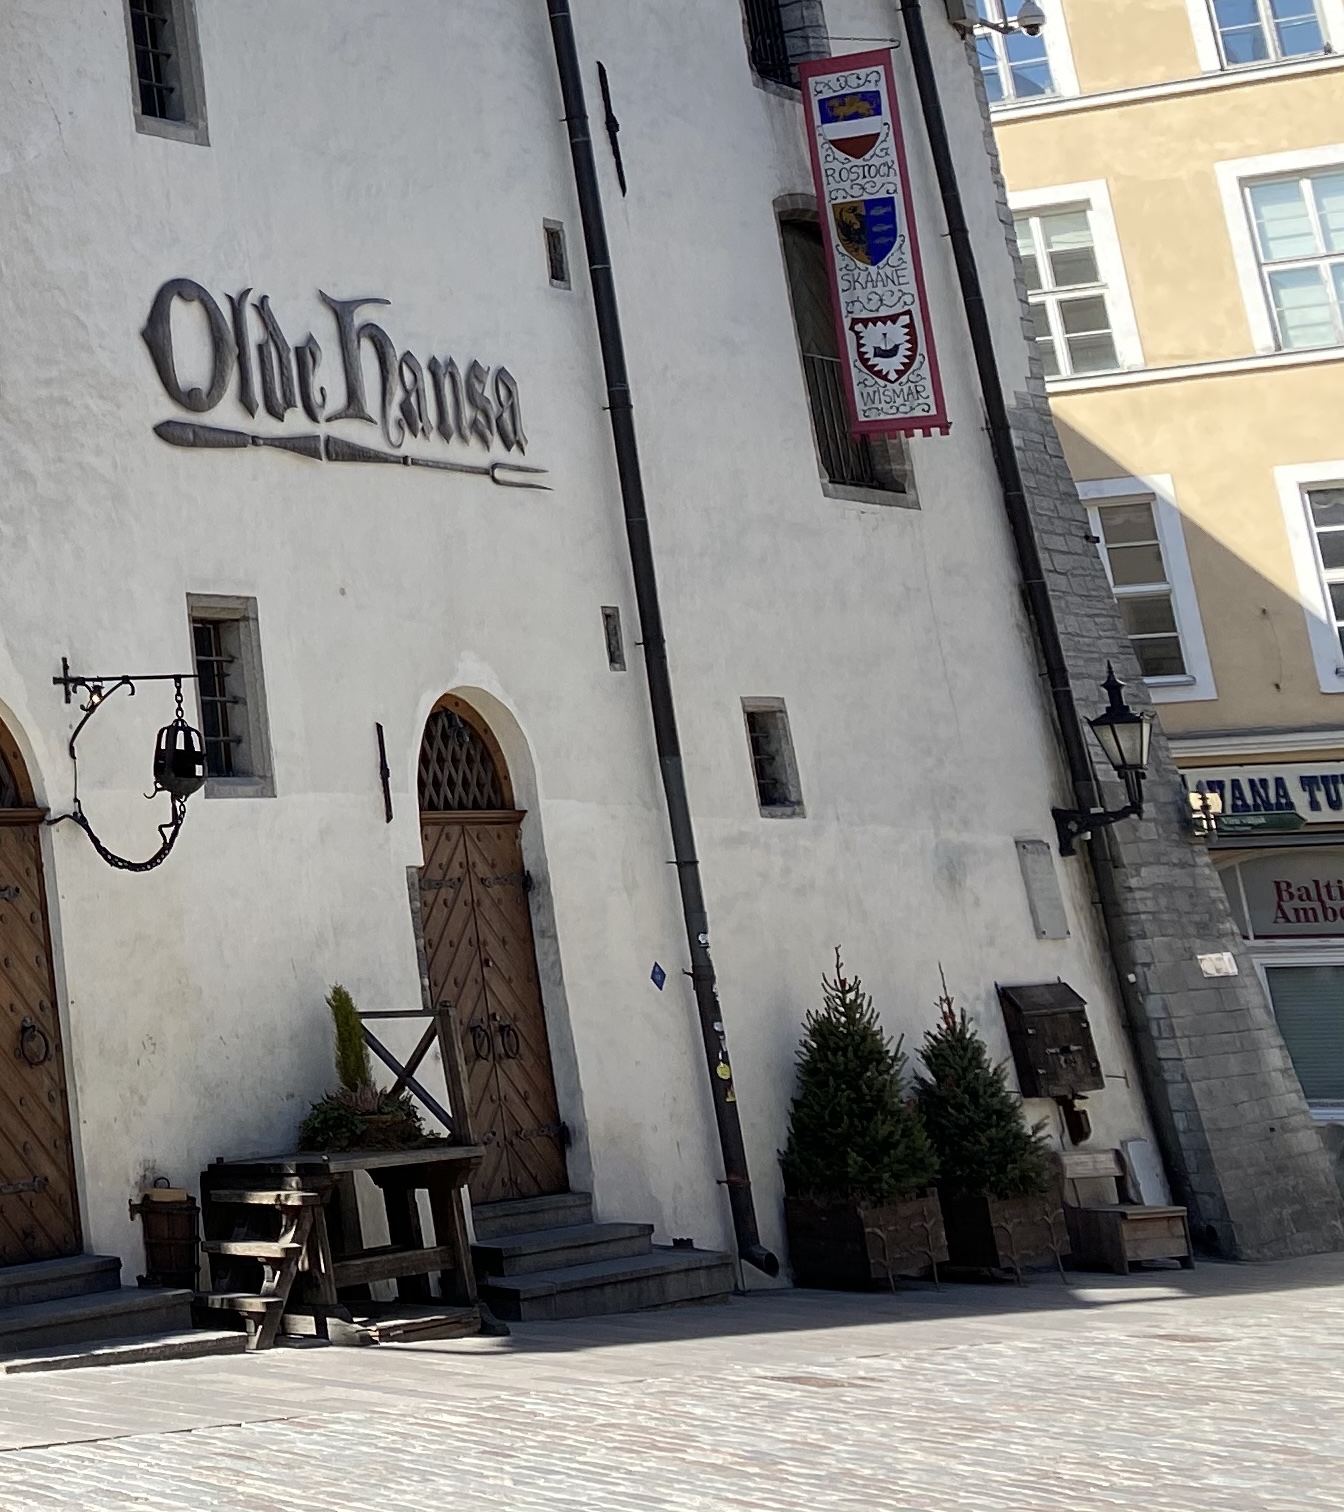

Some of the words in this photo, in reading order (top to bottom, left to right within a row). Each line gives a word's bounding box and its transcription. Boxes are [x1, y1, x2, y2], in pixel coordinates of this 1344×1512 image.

[825, 160, 897, 185] ROSTOCK
[841, 268, 910, 292] SKAANE
[141, 278, 326, 423] Olde
[860, 385, 930, 406] WISMAR
[1299, 773, 1344, 811] TU
